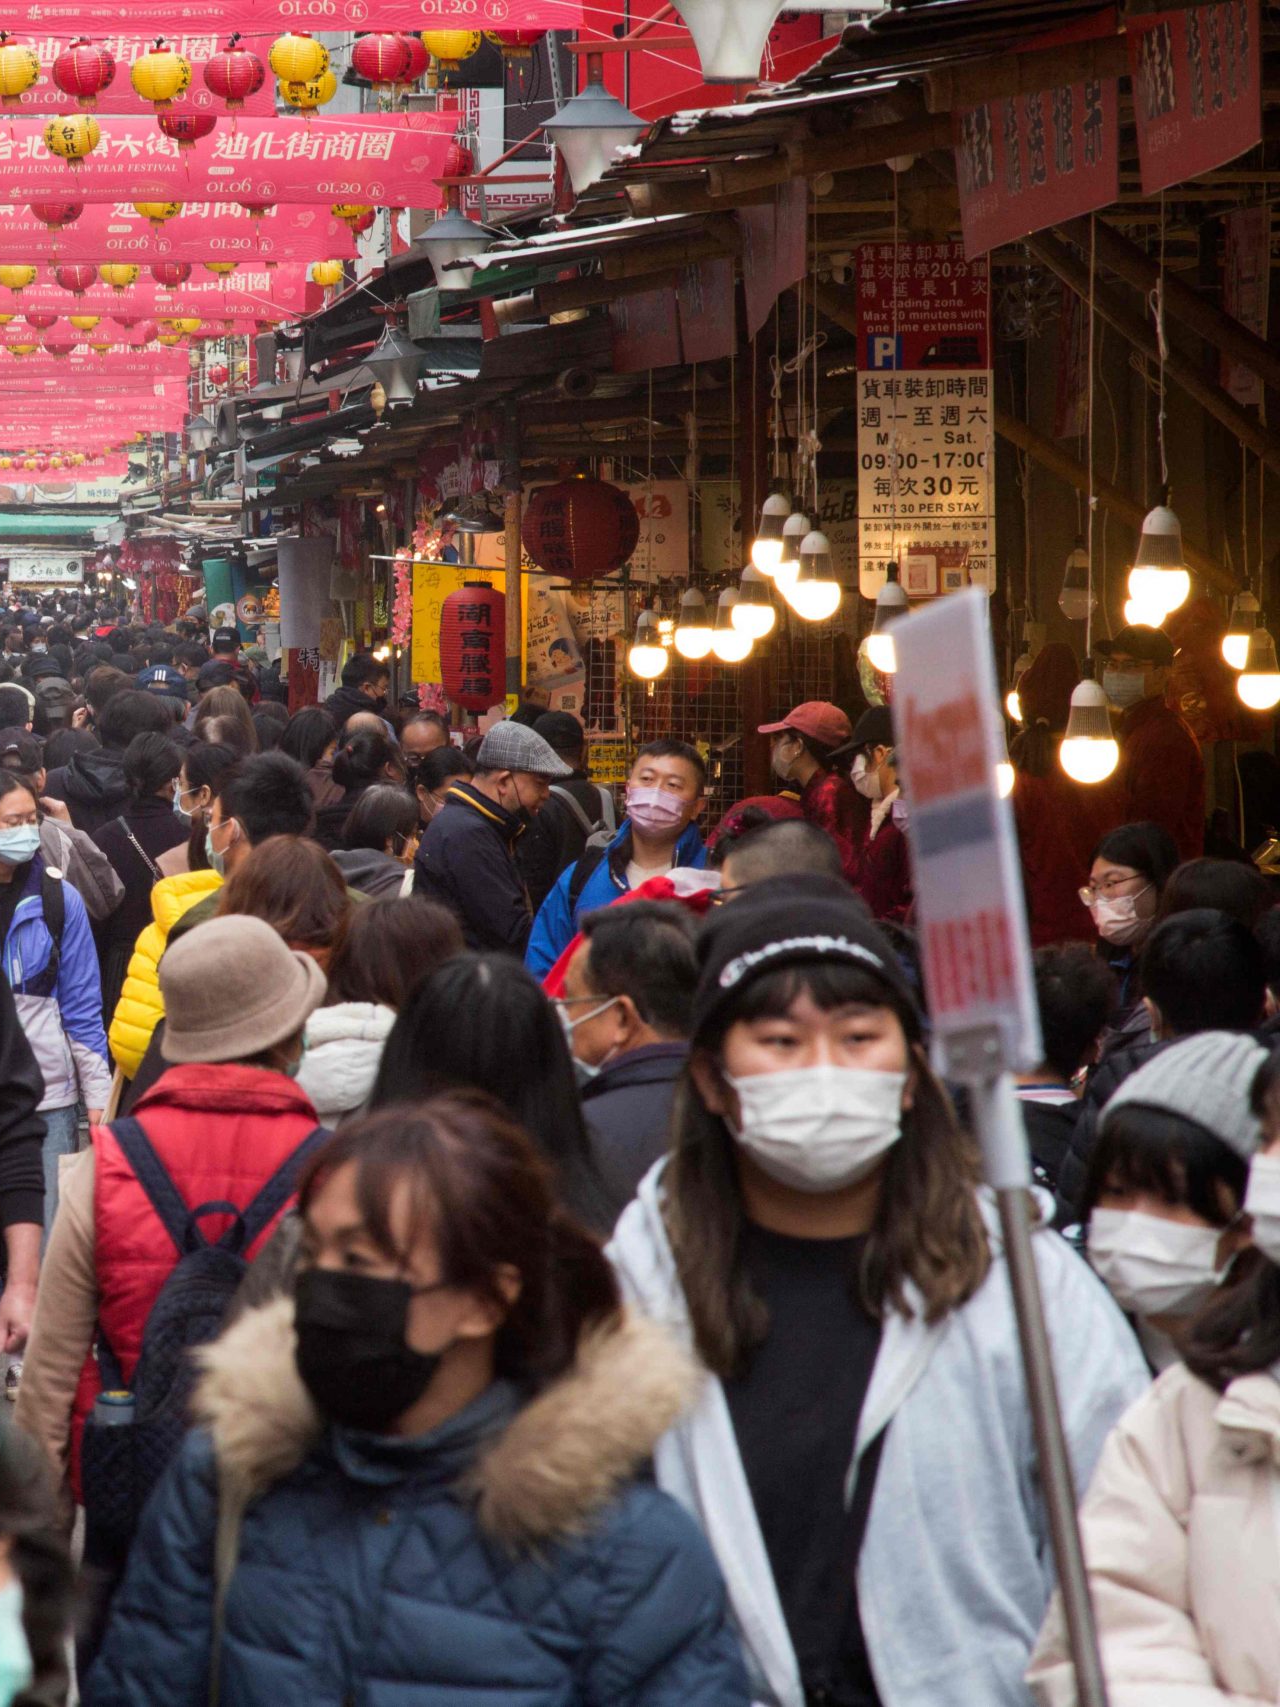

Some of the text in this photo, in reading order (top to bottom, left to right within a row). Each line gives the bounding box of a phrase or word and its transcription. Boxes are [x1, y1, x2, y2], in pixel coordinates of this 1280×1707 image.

[211, 130, 396, 161] 迪化街商圈
[28, 164, 65, 174] LUNAR
[68, 164, 93, 173] NEW
[97, 163, 124, 173] YEAR
[128, 163, 178, 173] FESTIVAL
[207, 177, 252, 193] 01.06
[317, 182, 362, 194] 01.20
[4, 222, 30, 230] YEAR
[106, 235, 149, 249] 01.06
[210, 238, 252, 249] 01.20
[881, 299, 966, 309] Loading zone.
[863, 311, 887, 321] Max
[909, 309, 957, 320] minutes
[961, 309, 986, 319] with
[867, 321, 985, 333] one ime extension.
[874, 337, 896, 367] P
[862, 376, 988, 400] 貨車裝卸時間
[861, 405, 988, 428] 週一至週六
[876, 432, 917, 446] M.
[944, 431, 977, 444] Sat.
[873, 476, 980, 497] 每次30元
[900, 504, 915, 513] 30
[919, 503, 944, 513] PER
[947, 502, 980, 513] STAY
